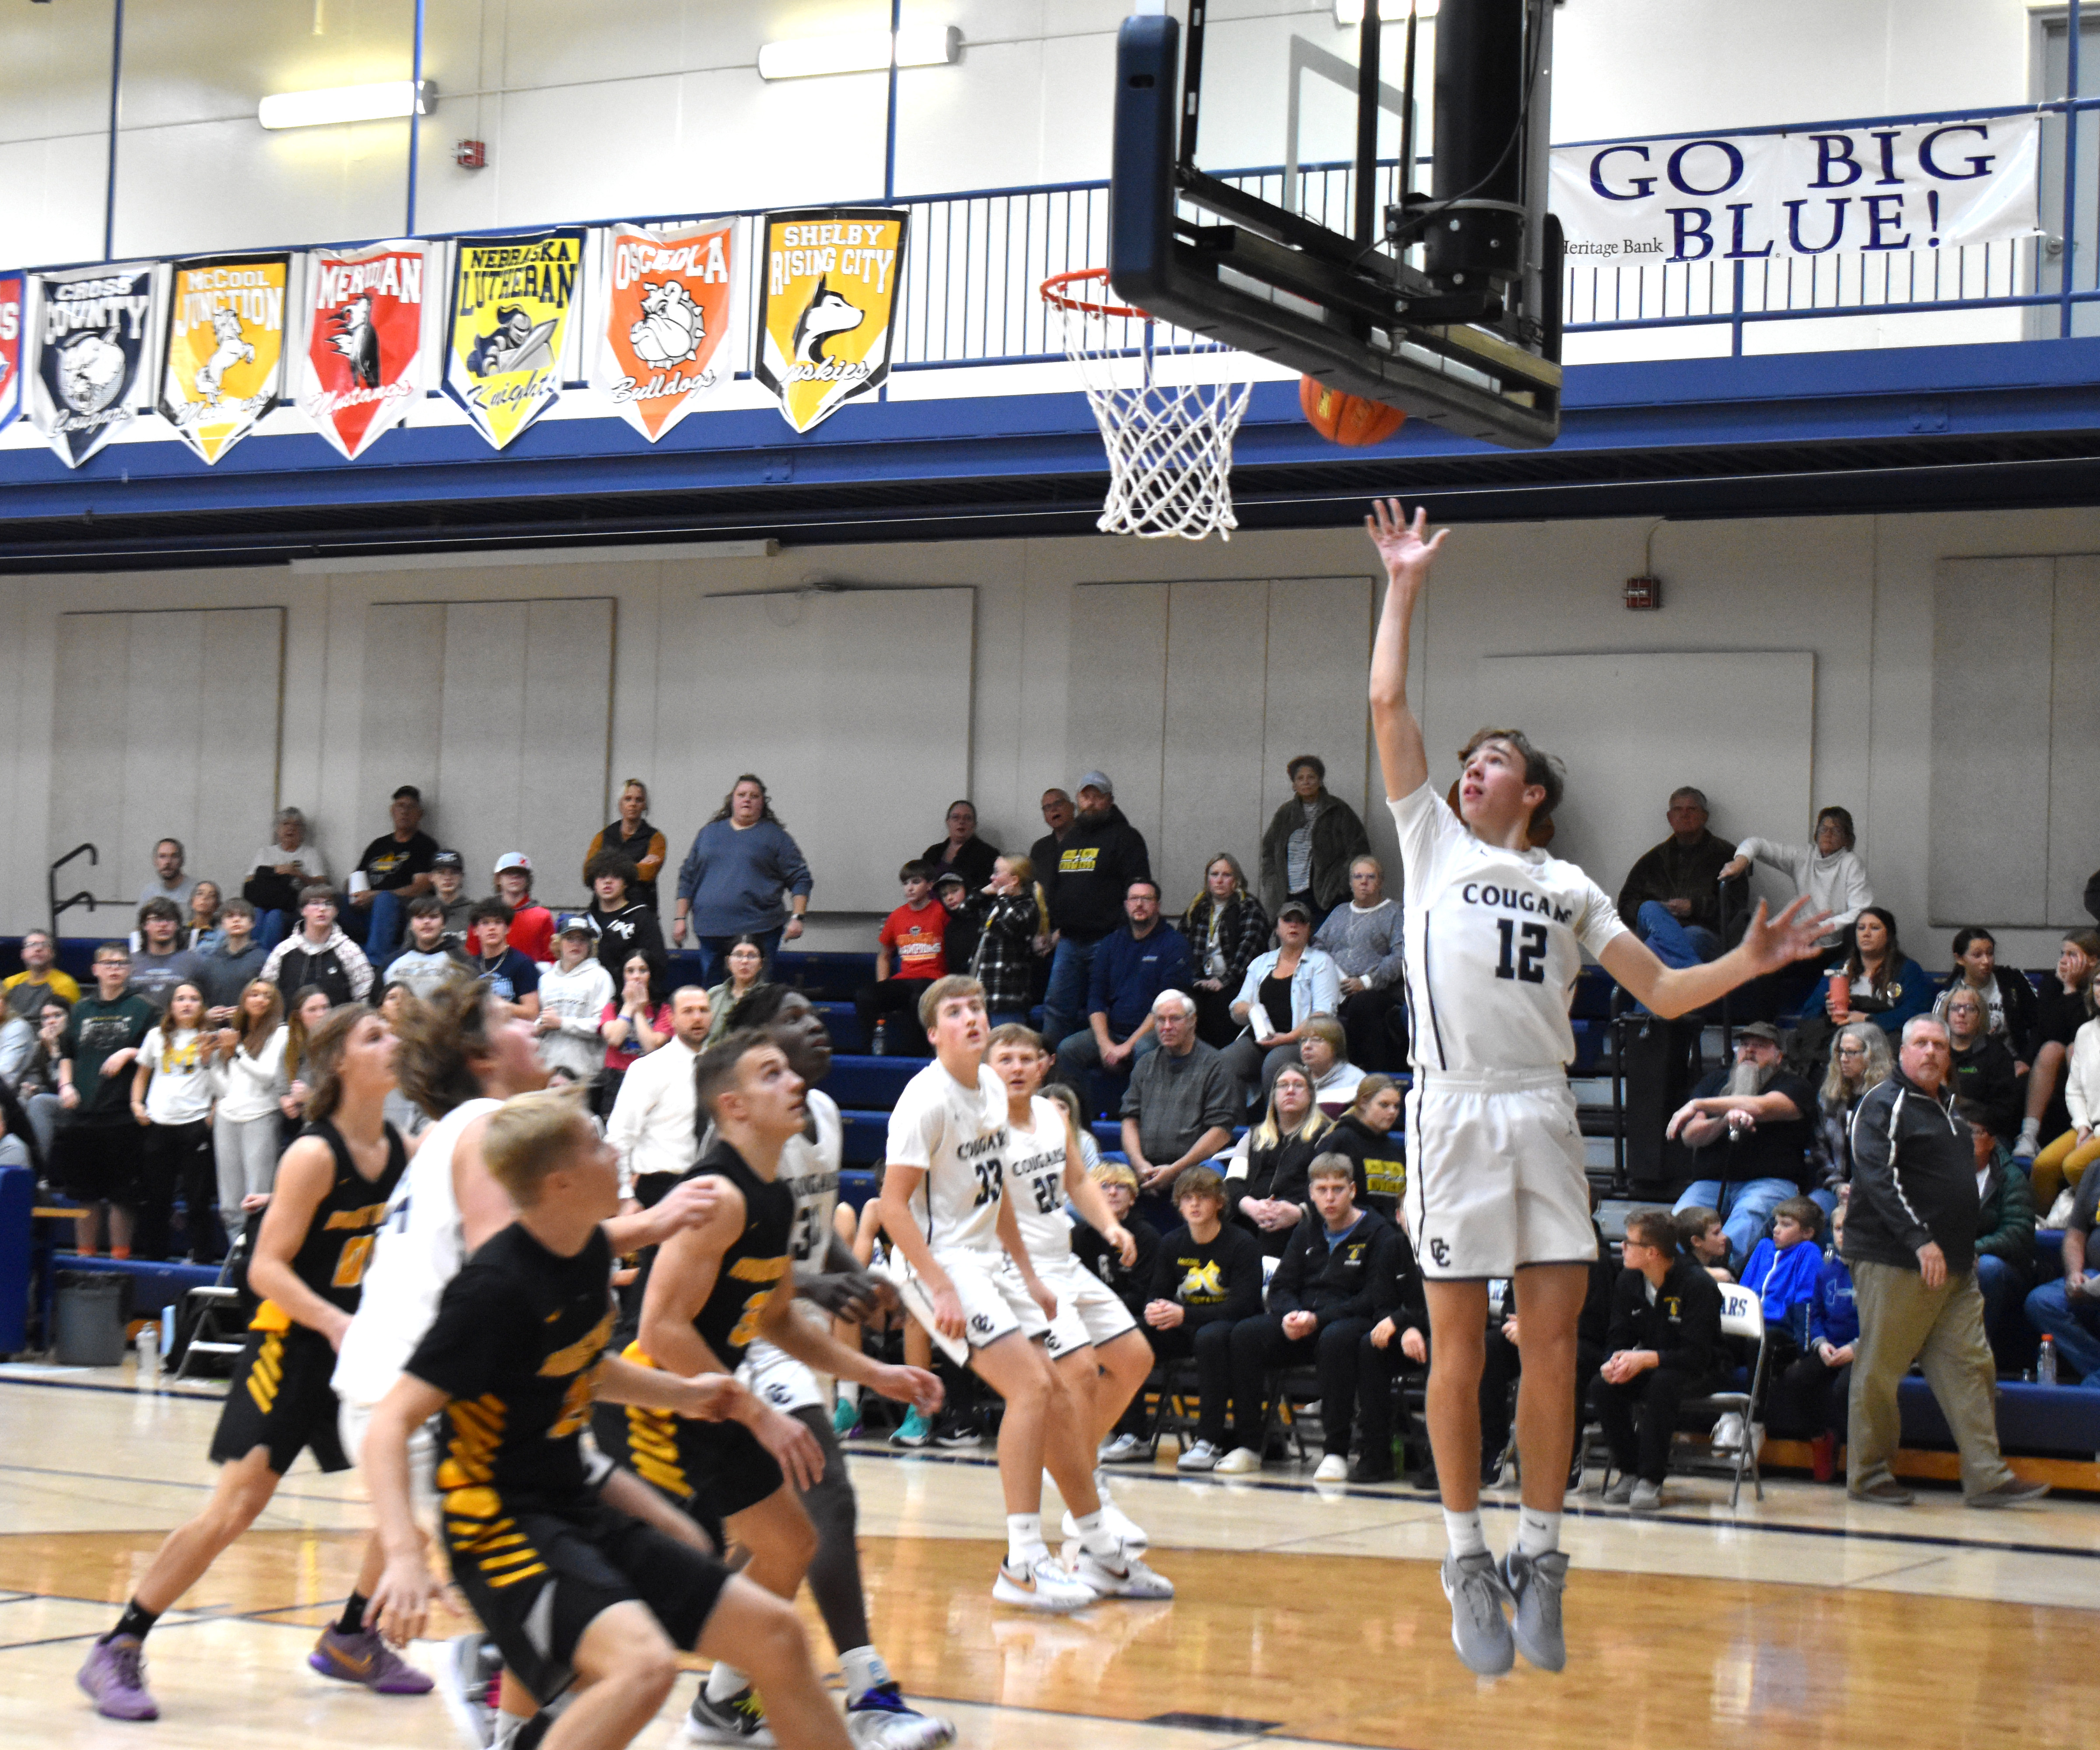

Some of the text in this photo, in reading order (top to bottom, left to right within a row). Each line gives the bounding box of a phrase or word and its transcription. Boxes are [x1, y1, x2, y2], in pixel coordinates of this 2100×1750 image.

[1589, 125, 1996, 201] GO BIG
[784, 223, 885, 247] SHELBY
[1623, 237, 1663, 253] Bank
[1664, 190, 1941, 263] BLUE!
[54, 276, 133, 301] CROSS
[616, 237, 728, 290] OSCEOLA
[770, 246, 895, 296] RISING CITY
[611, 369, 716, 404] Bulldogs
[1495, 918, 1547, 984] 12
